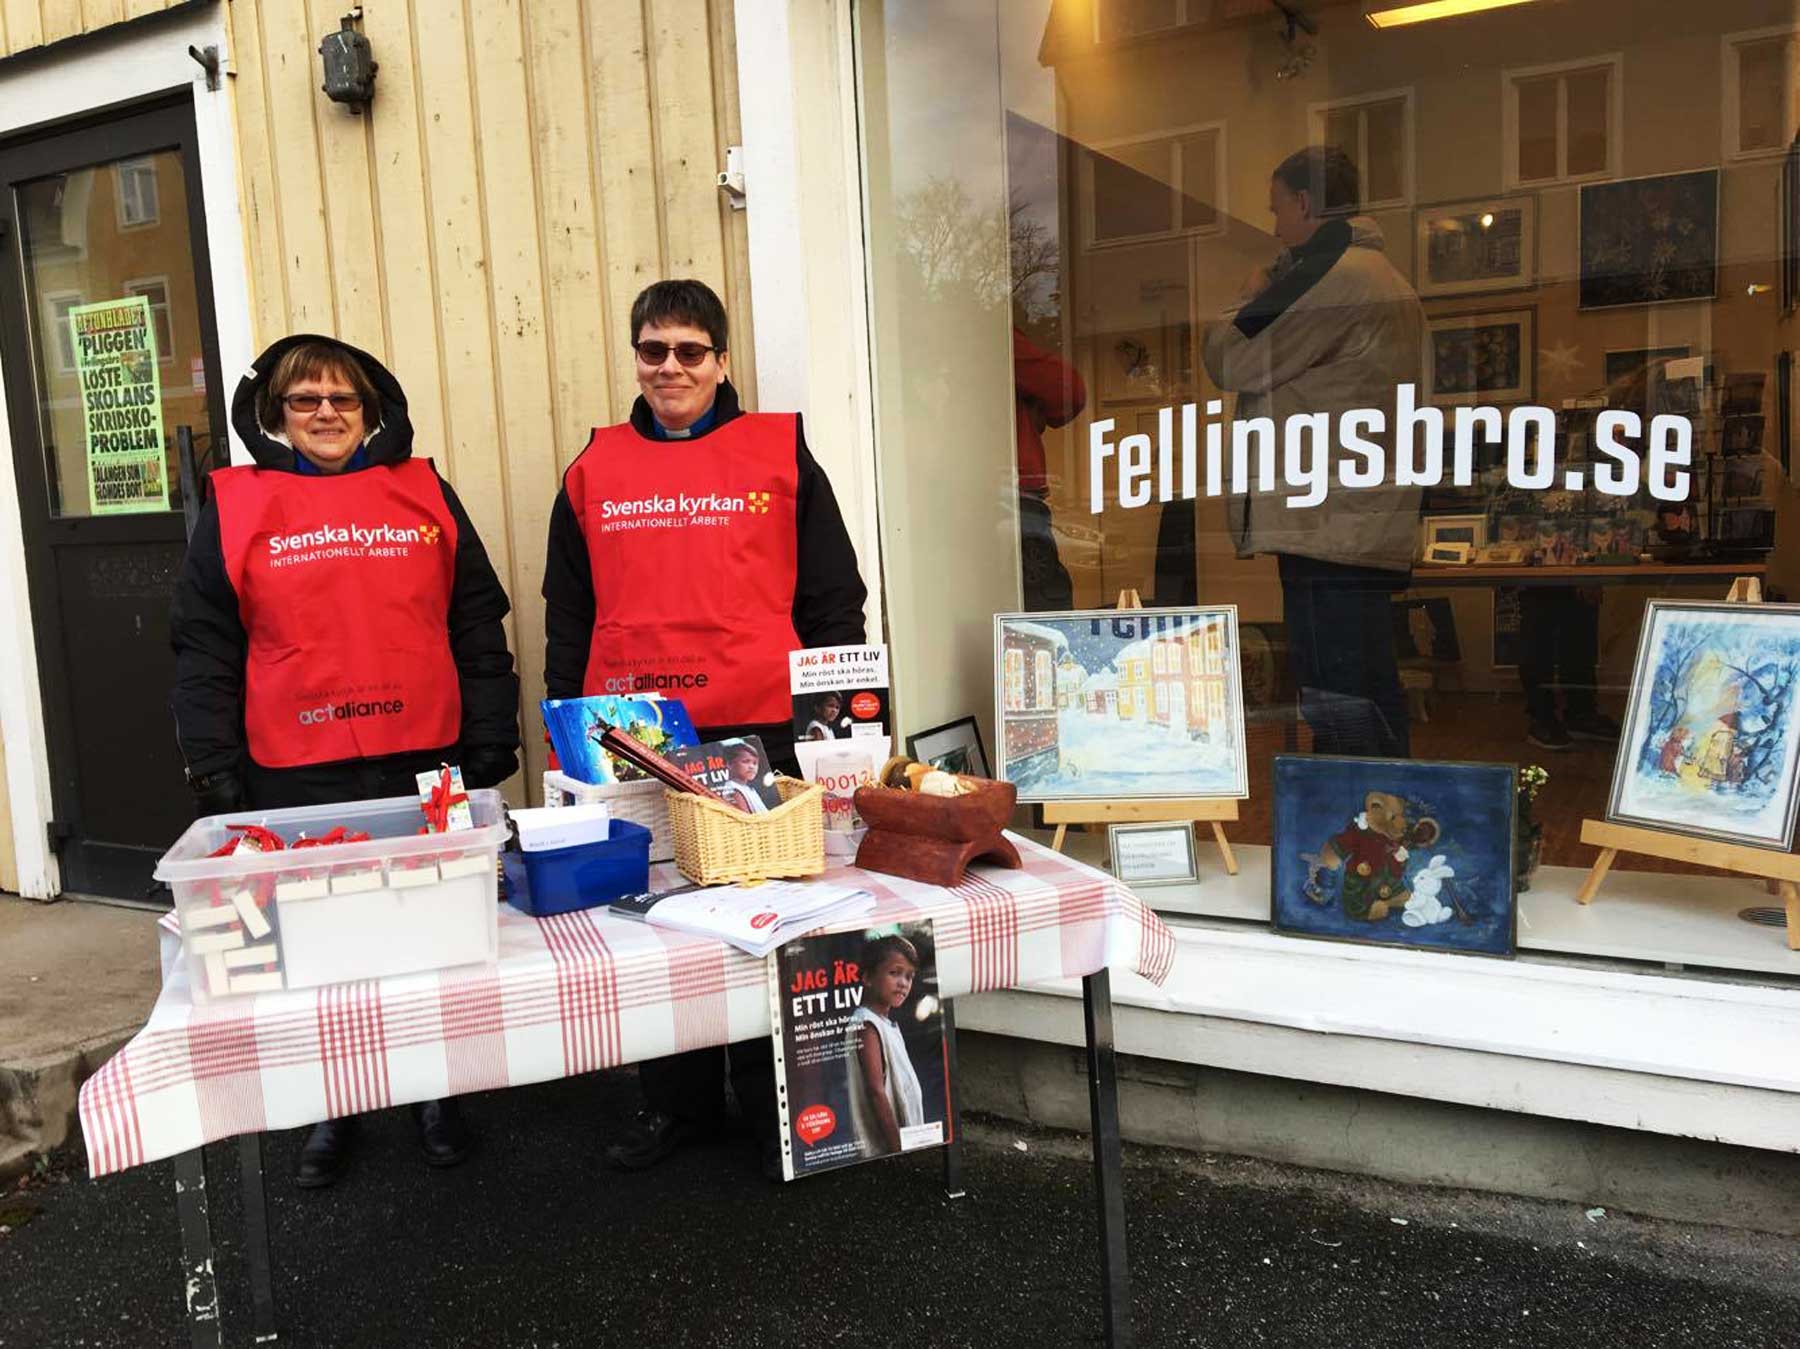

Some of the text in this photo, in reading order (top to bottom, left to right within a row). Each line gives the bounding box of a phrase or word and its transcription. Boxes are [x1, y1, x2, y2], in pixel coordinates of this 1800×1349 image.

[83, 367, 122, 390] LÖSTE
[86, 384, 155, 412] SKOLANS
[89, 407, 157, 432] SKRIDSKO-
[91, 428, 159, 454] PROBLEM
[1089, 383, 1693, 514] Fellingsbro.se
[601, 493, 744, 519] Svenska kyrkan
[601, 516, 730, 533] INTERNATIONELLT ARBETE
[269, 523, 419, 554] Svenska kyrkan
[269, 547, 409, 568] INTERNATIONELLT ARBETE
[797, 651, 880, 667] JAG ÄR ETT LIV
[801, 670, 817, 678] Min
[818, 669, 835, 677] röst
[816, 678, 845, 687] önskan
[707, 755, 726, 770] ÄR
[710, 769, 730, 783] LIV
[790, 959, 860, 993] JAG ÄR
[792, 985, 864, 1017] ETT LIV
[794, 1024, 809, 1033] Min
[809, 1021, 824, 1030] röst
[825, 1018, 838, 1026] ska
[795, 1034, 809, 1042] Min
[810, 1029, 835, 1039] önskan
[836, 1026, 844, 1034] är
